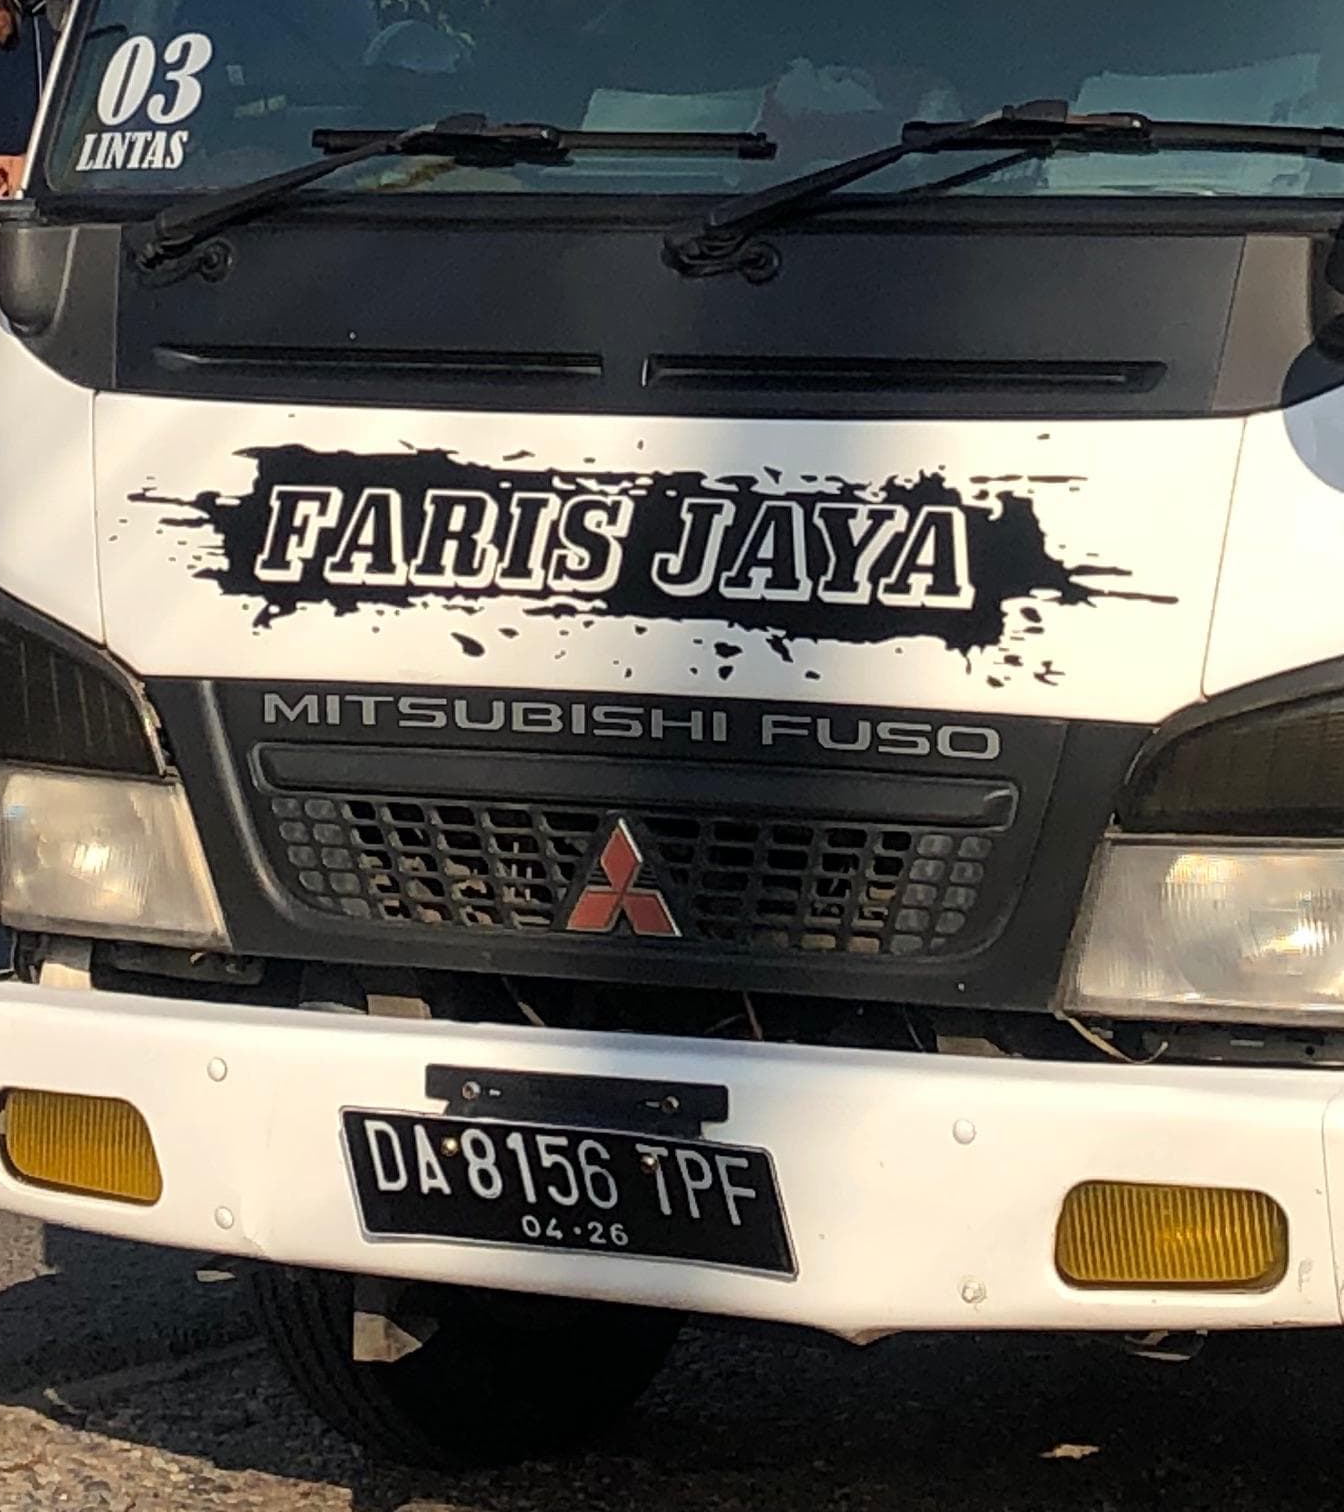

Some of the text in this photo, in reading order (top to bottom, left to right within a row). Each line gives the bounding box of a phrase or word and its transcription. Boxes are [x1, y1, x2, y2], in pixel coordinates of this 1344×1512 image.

[97, 33, 213, 126] 03
[75, 130, 189, 171] LINTAS
[256, 484, 976, 610] FARIS JAYA
[262, 693, 1001, 761] MITSUBISHI FUSO
[363, 1120, 757, 1226] DA 8156 TPF
